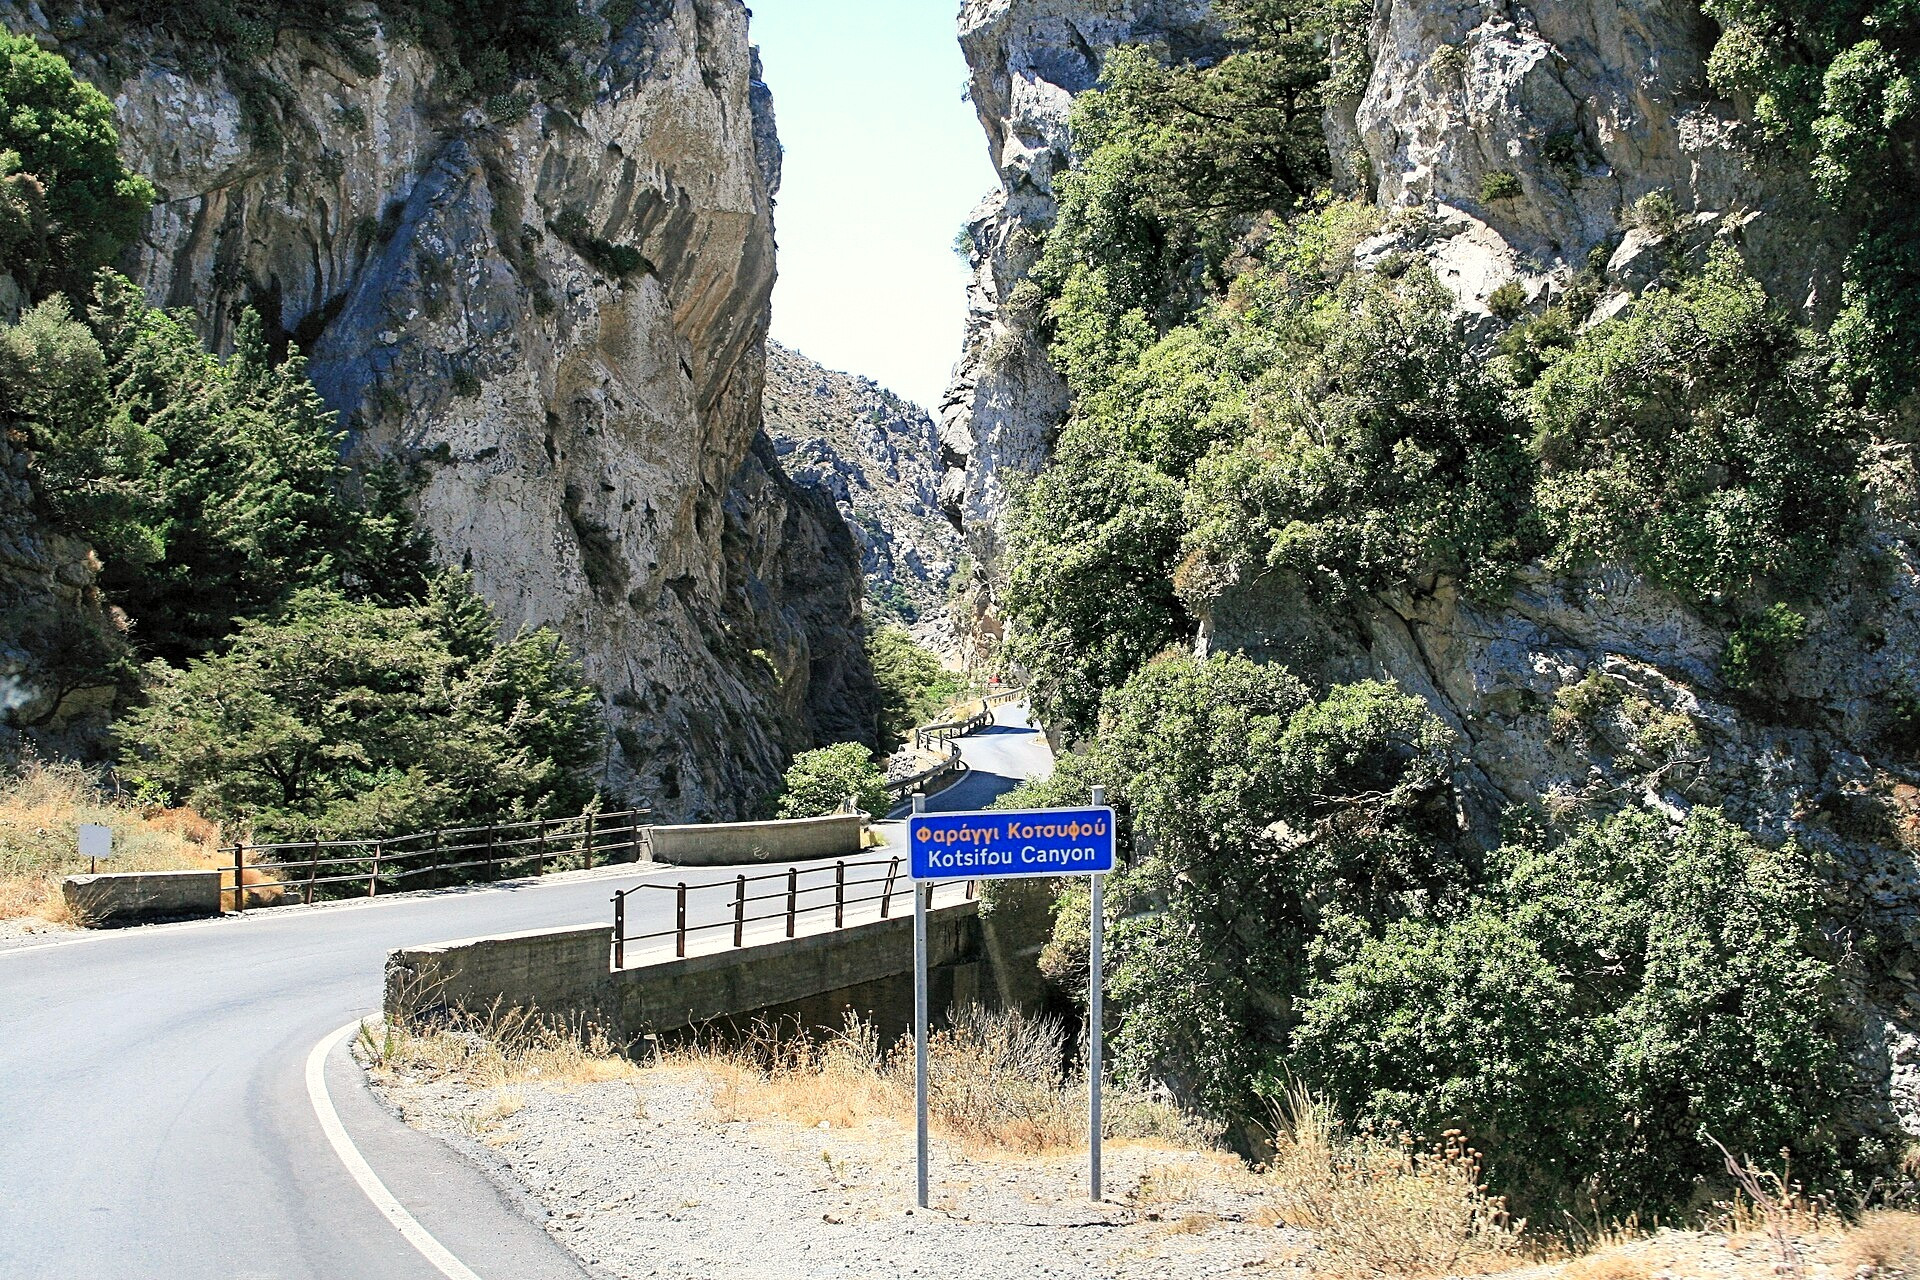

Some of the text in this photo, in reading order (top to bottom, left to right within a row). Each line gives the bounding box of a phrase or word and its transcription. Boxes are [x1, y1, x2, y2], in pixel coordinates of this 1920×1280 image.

[916, 818, 1106, 846] Φαράγγι Κοτσυφού
[928, 846, 1095, 868] Kotsifou Canyon
